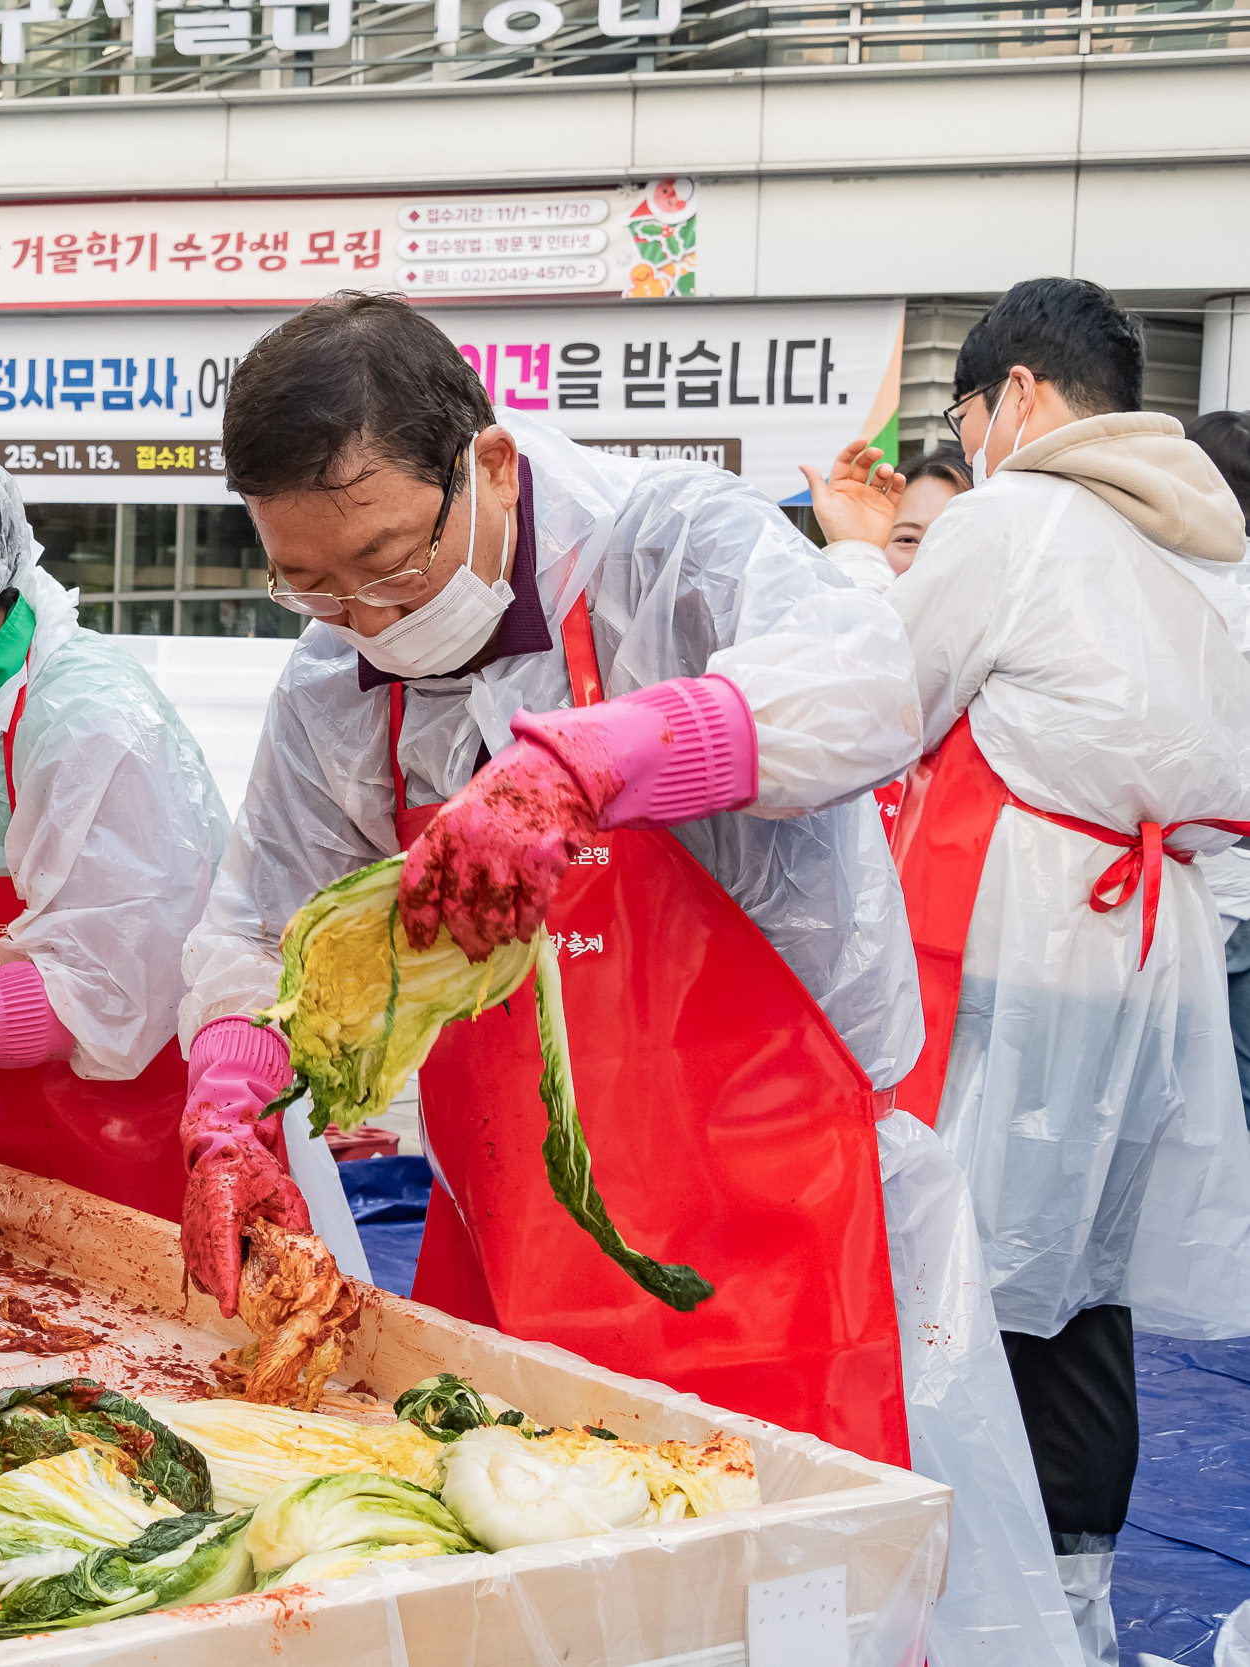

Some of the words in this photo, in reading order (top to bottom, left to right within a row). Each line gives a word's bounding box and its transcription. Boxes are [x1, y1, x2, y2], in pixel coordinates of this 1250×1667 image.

[426, 207, 483, 224] 접수기간
[498, 205, 527, 222] 11/1
[547, 203, 591, 220] 11/30
[12, 231, 158, 276] 겨울학기
[168, 231, 289, 273] 수강생
[300, 229, 382, 270] 모집
[426, 237, 481, 255] 접수방법
[495, 236, 523, 253] 방문
[529, 236, 542, 251] 및
[547, 233, 591, 251] 인터넷
[423, 269, 448, 285] 문의
[622, 337, 849, 411] 받습니다.
[86, 444, 121, 470] 13.
[569, 846, 610, 866] 은행
